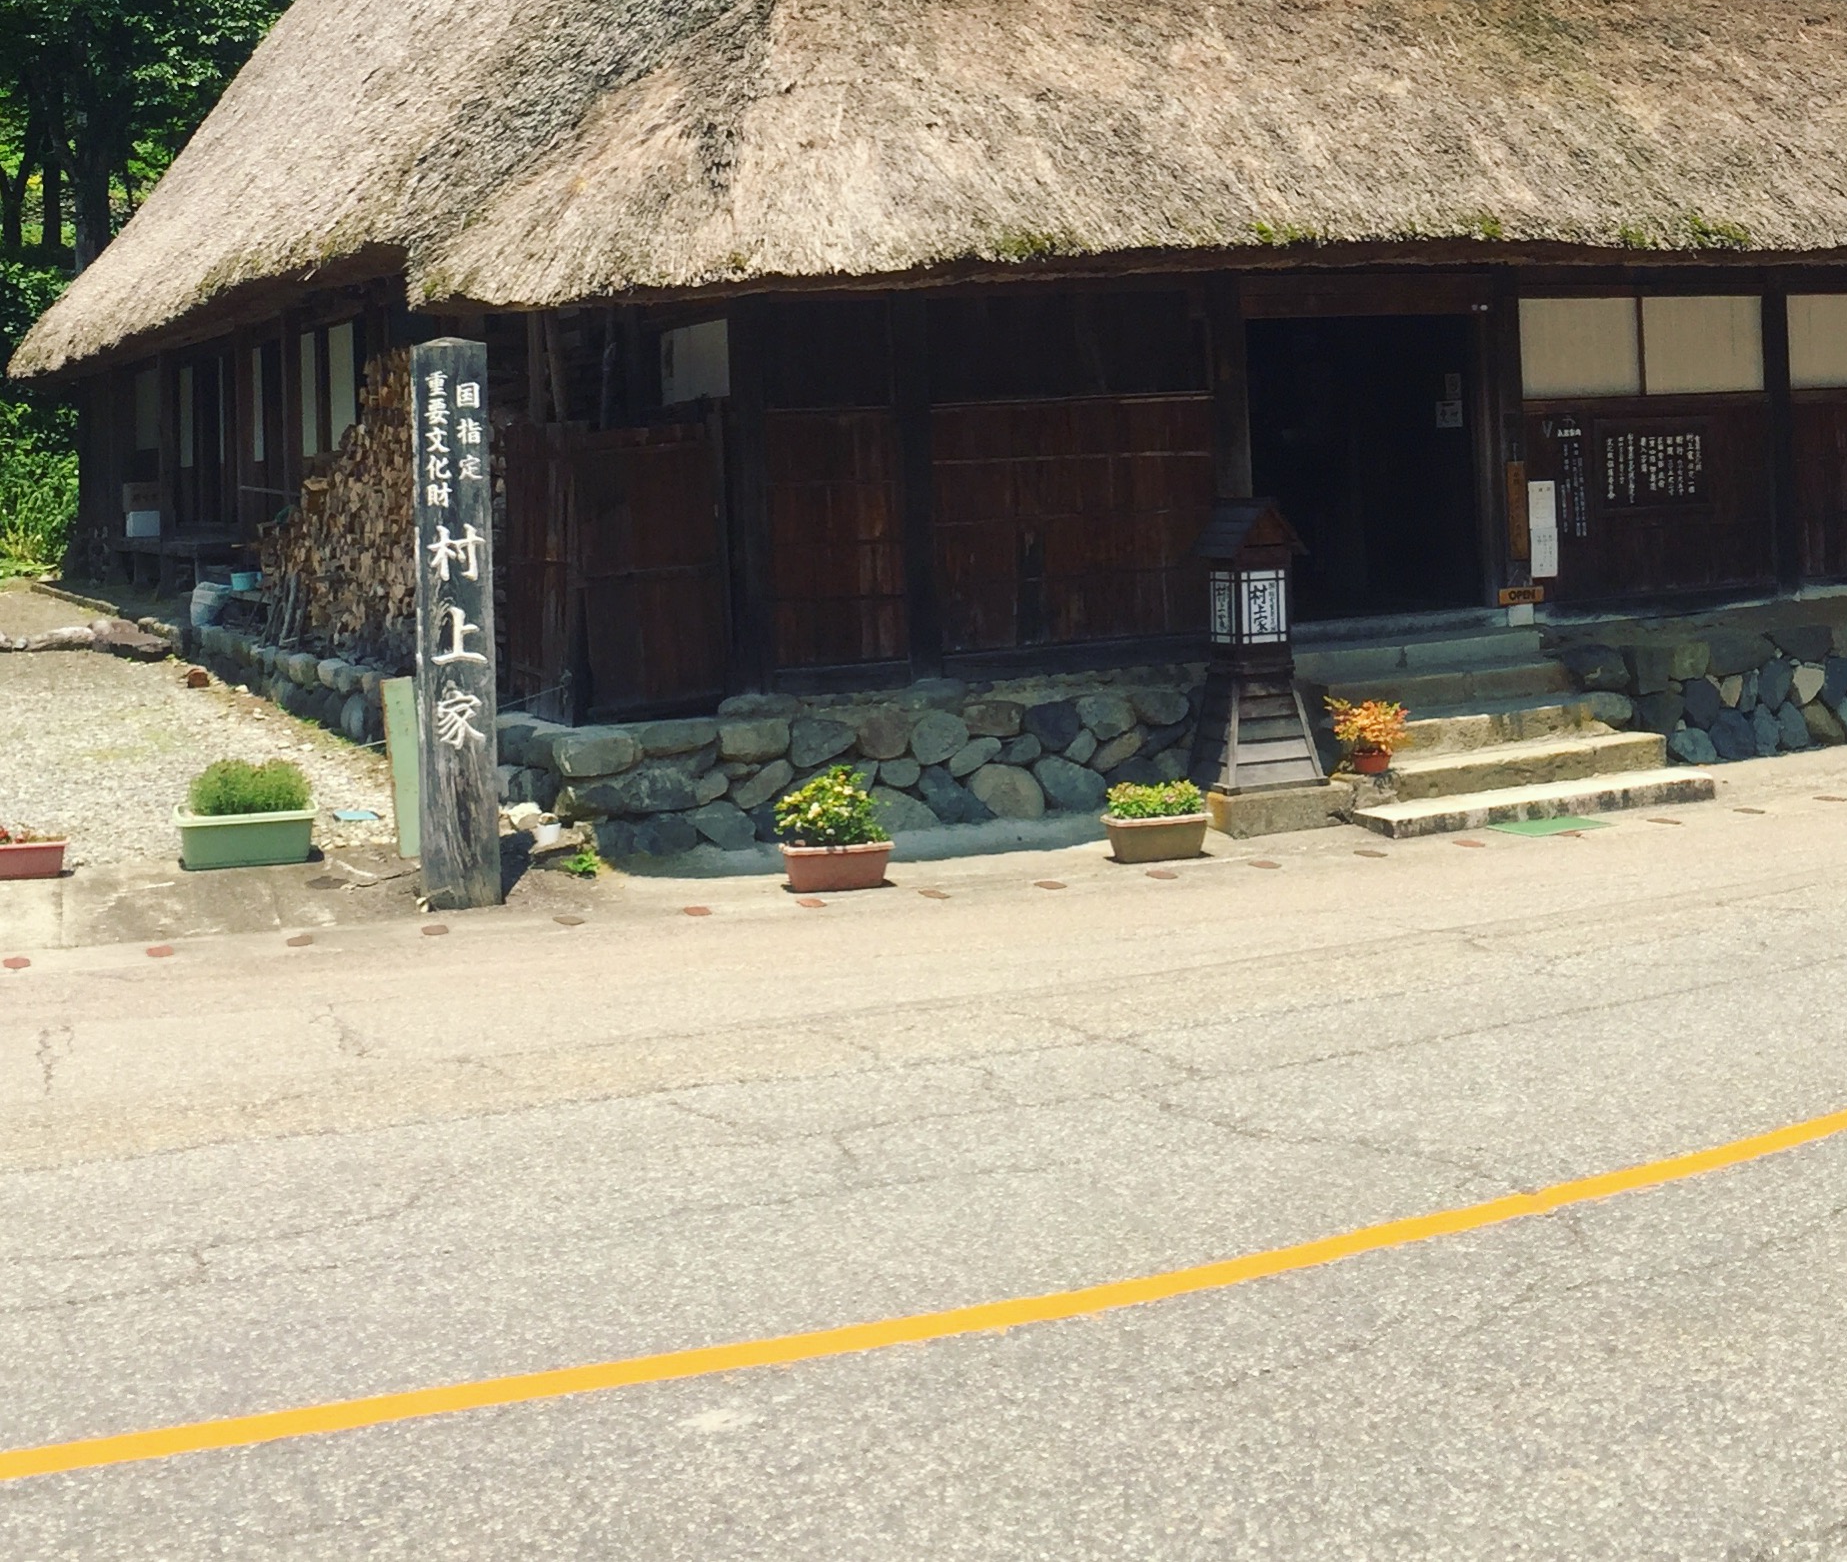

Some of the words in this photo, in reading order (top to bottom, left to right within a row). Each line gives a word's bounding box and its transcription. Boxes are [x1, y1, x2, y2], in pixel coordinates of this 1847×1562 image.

[424, 370, 454, 508] 重要文化財
[456, 381, 483, 481] 国指定
[428, 522, 488, 747] 村上家
[1250, 584, 1268, 633] 村上家
[1508, 589, 1536, 600] OPEN
